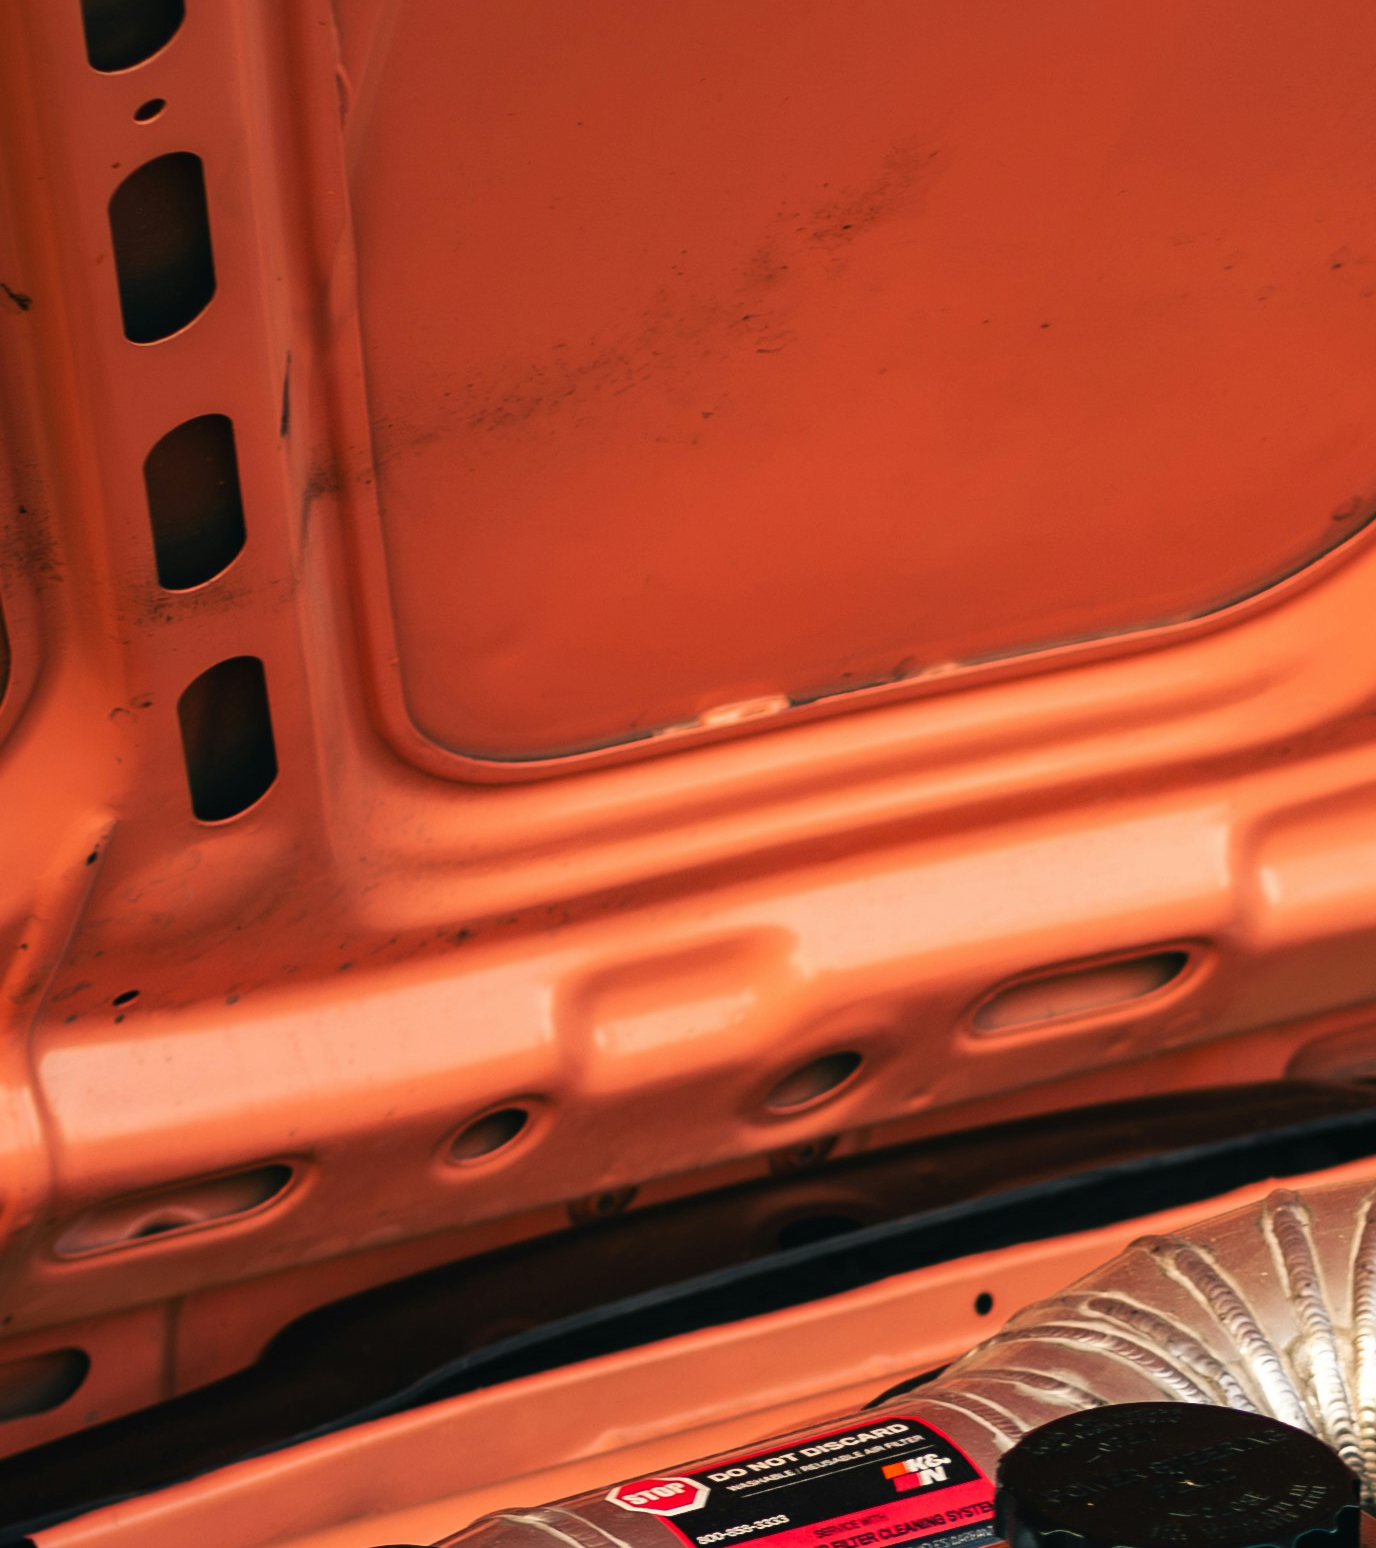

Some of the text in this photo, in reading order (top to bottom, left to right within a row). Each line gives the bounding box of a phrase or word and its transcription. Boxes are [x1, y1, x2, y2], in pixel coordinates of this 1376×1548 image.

[708, 1423, 910, 1482] DO NOT DISCARD
[726, 1469, 796, 1491] WASHABLE
[801, 1450, 864, 1472] REUSABLE
[864, 1444, 886, 1456] AIR
[884, 1434, 926, 1449] FILTER
[622, 1483, 686, 1505] STOP
[696, 1514, 790, 1545] 800-858-3333
[814, 1514, 886, 1538] SERVICE WITH
[878, 1513, 945, 1539] CLEANING
[951, 1525, 994, 1545] WARRANT
